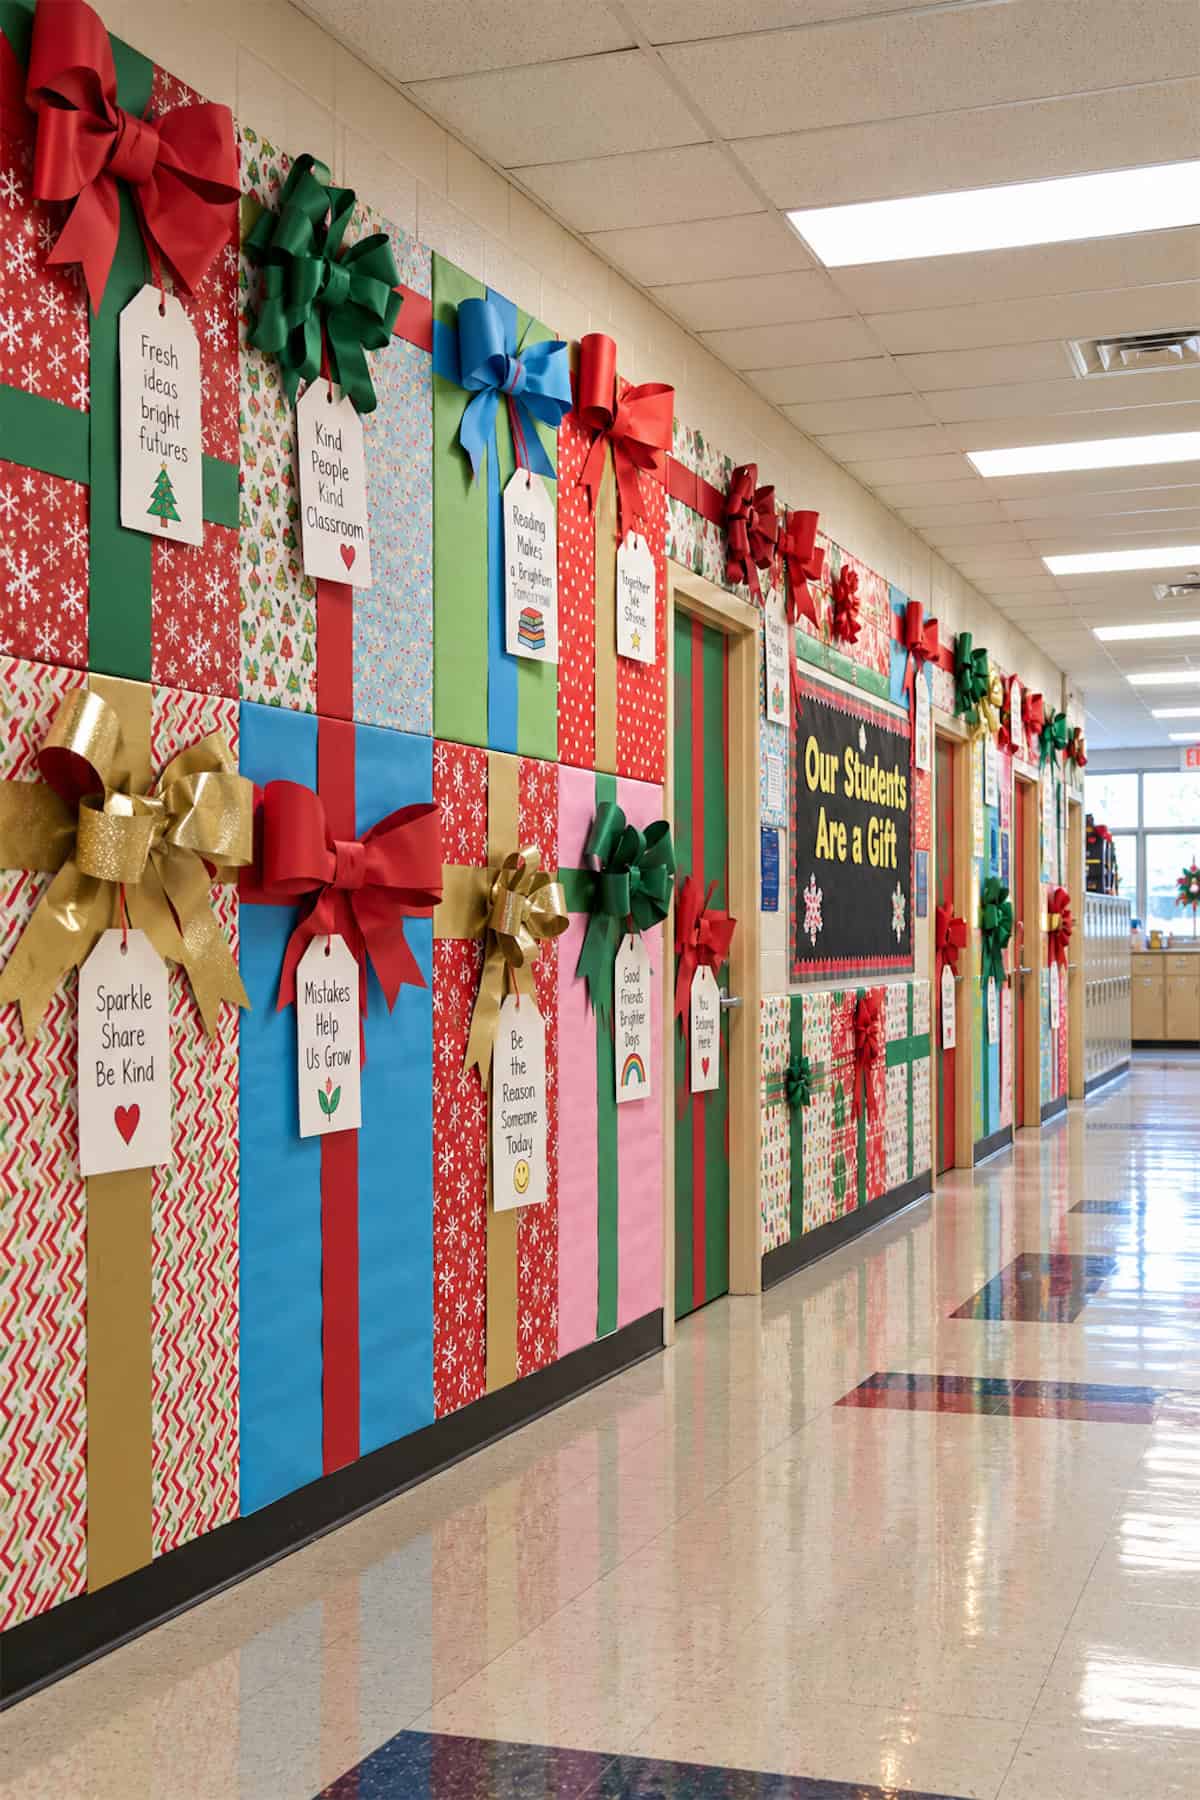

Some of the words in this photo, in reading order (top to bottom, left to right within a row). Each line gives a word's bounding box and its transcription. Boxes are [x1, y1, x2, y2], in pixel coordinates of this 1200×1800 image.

[140, 334, 179, 370] Fresh
[143, 369, 178, 400] ideas
[141, 396, 181, 434] bright
[138, 428, 189, 464] futures
[315, 421, 343, 451] Kind
[311, 450, 350, 482] People
[318, 481, 345, 508] Kind
[306, 506, 366, 541] Classroom
[512, 505, 546, 542] Reading
[516, 535, 543, 561] Makes
[510, 565, 516, 577] a
[805, 735, 839, 794] Our
[844, 745, 907, 811] Students
[815, 806, 847, 862] Are
[852, 824, 863, 864] a
[868, 816, 898, 869] Gift
[95, 983, 153, 1020] Sparkle
[304, 979, 351, 1004] Mistakes
[101, 1022, 145, 1049] Share
[315, 1011, 339, 1042] Help
[510, 1030, 524, 1050] Be
[96, 1060, 116, 1087] Be
[122, 1056, 155, 1084] Kind
[305, 1047, 321, 1070] Us
[324, 1045, 352, 1068] Grow
[510, 1056, 527, 1076] the
[502, 1083, 536, 1103] Reason
[501, 1109, 538, 1130] Someone
[505, 1132, 533, 1158] Today
